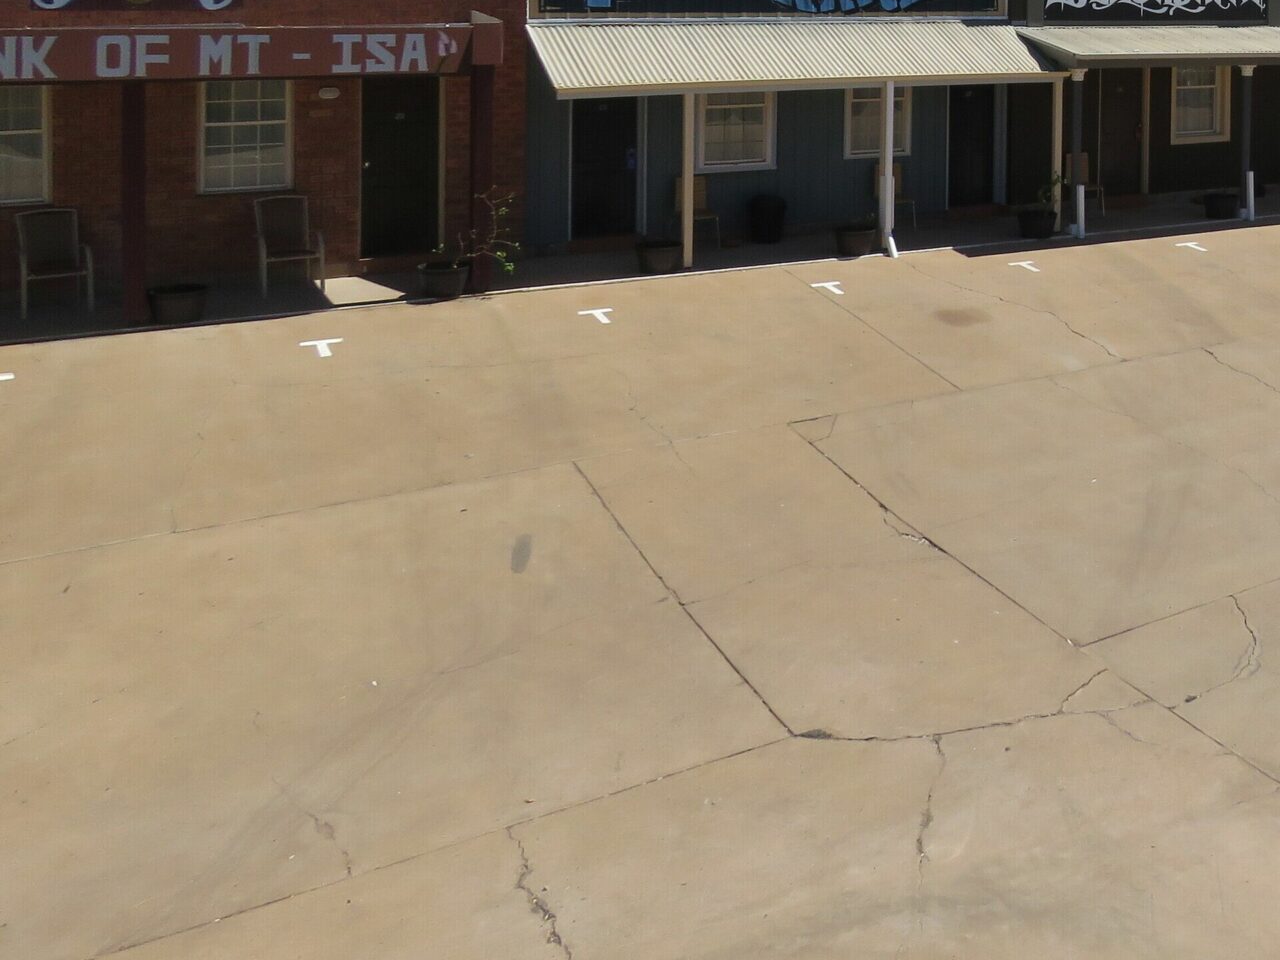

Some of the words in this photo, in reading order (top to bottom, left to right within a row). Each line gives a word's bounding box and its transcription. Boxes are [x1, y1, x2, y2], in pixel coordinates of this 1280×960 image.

[96, 34, 170, 78] OF
[198, 34, 270, 76] MT
[292, 52, 312, 61] -
[332, 33, 428, 74] ISA
